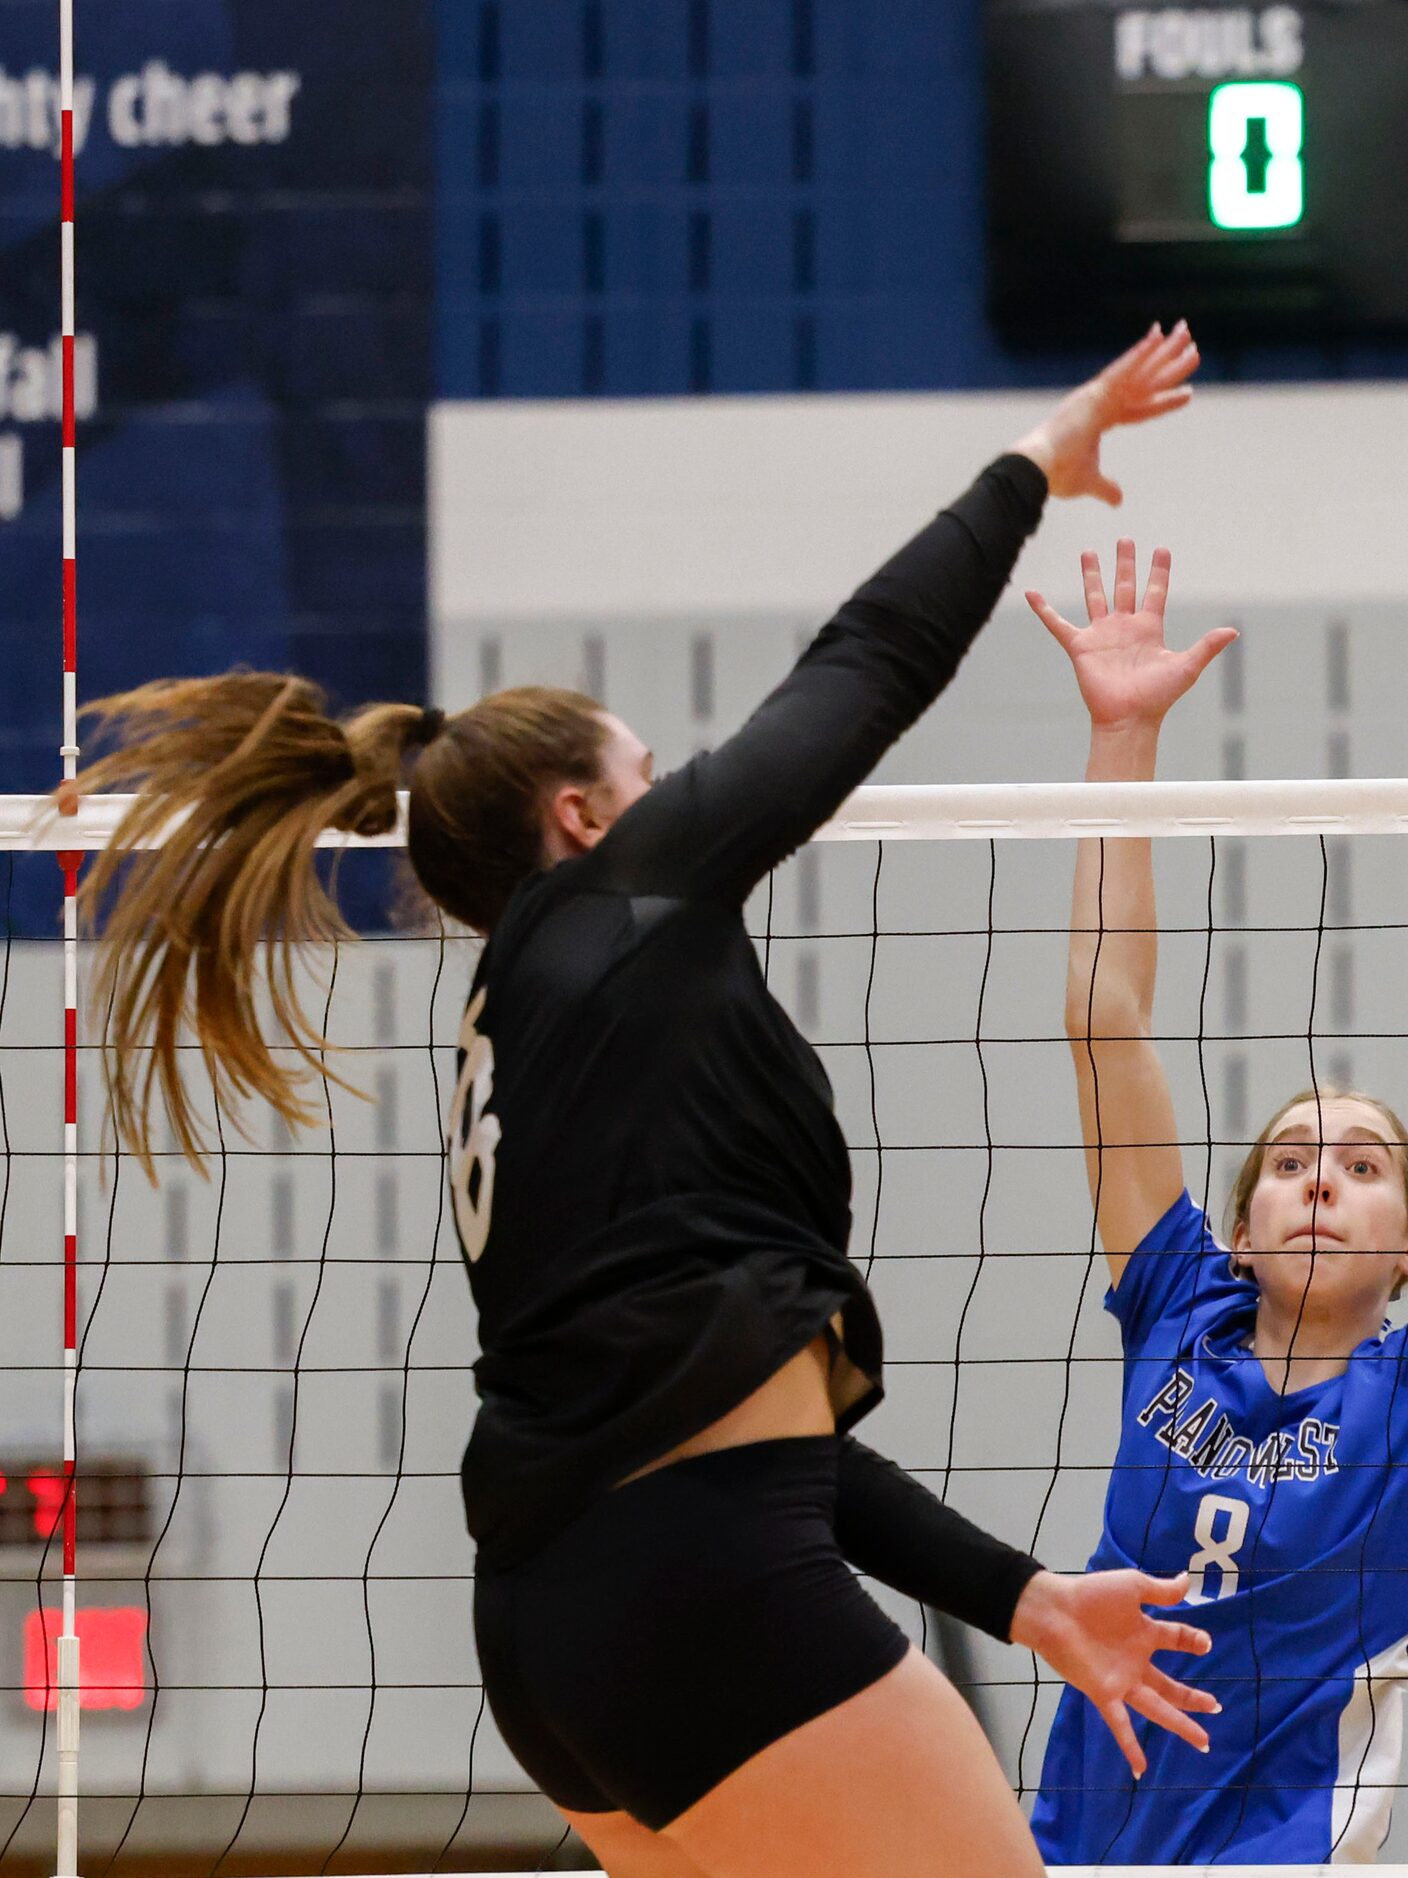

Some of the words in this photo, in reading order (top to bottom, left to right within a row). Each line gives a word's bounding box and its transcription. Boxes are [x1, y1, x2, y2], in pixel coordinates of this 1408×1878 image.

[1114, 5, 1303, 79] FOULS
[108, 59, 299, 147] cheer
[1209, 81, 1303, 230] 0
[1183, 1493, 1250, 1605] 8
